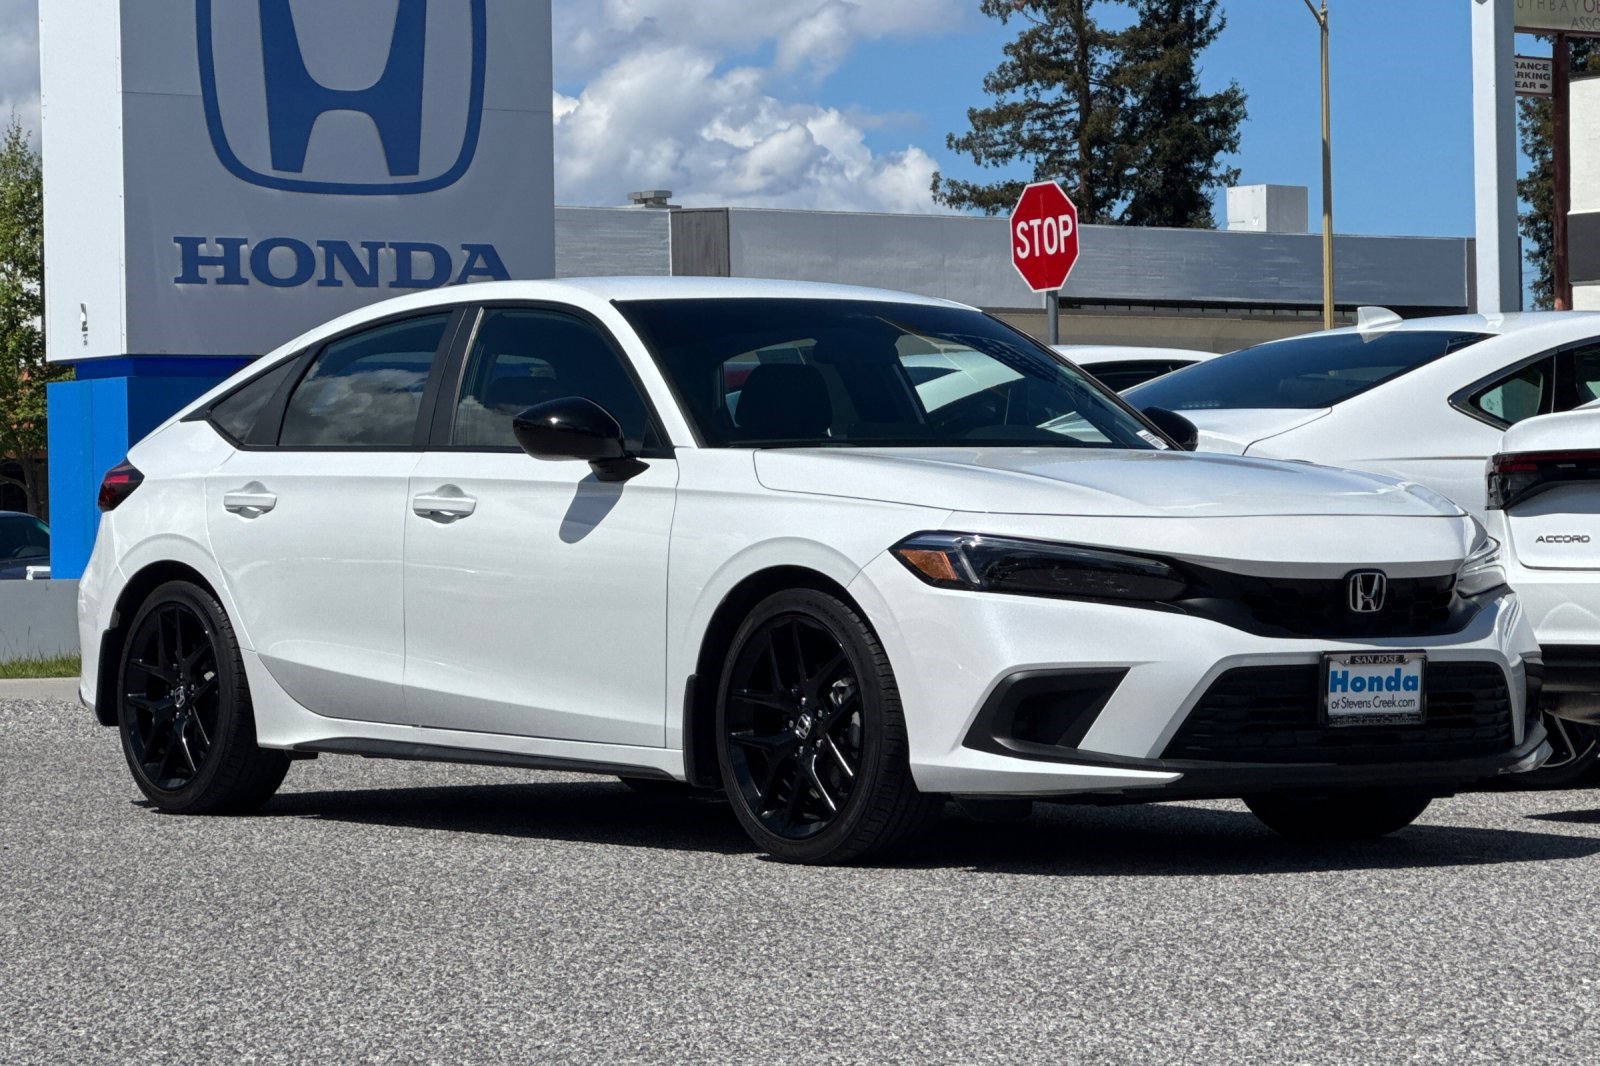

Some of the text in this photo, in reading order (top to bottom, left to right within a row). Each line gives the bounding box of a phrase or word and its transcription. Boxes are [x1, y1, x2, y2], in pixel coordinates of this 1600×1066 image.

[1514, 71, 1551, 81] RKING
[1016, 214, 1073, 259] STOP
[173, 236, 512, 289] HONDA
[1535, 534, 1591, 544] ACCORD
[1354, 655, 1400, 664] SAN JOSE
[1330, 668, 1418, 693] Honda
[1331, 694, 1416, 709] of Stevens Creek.com
